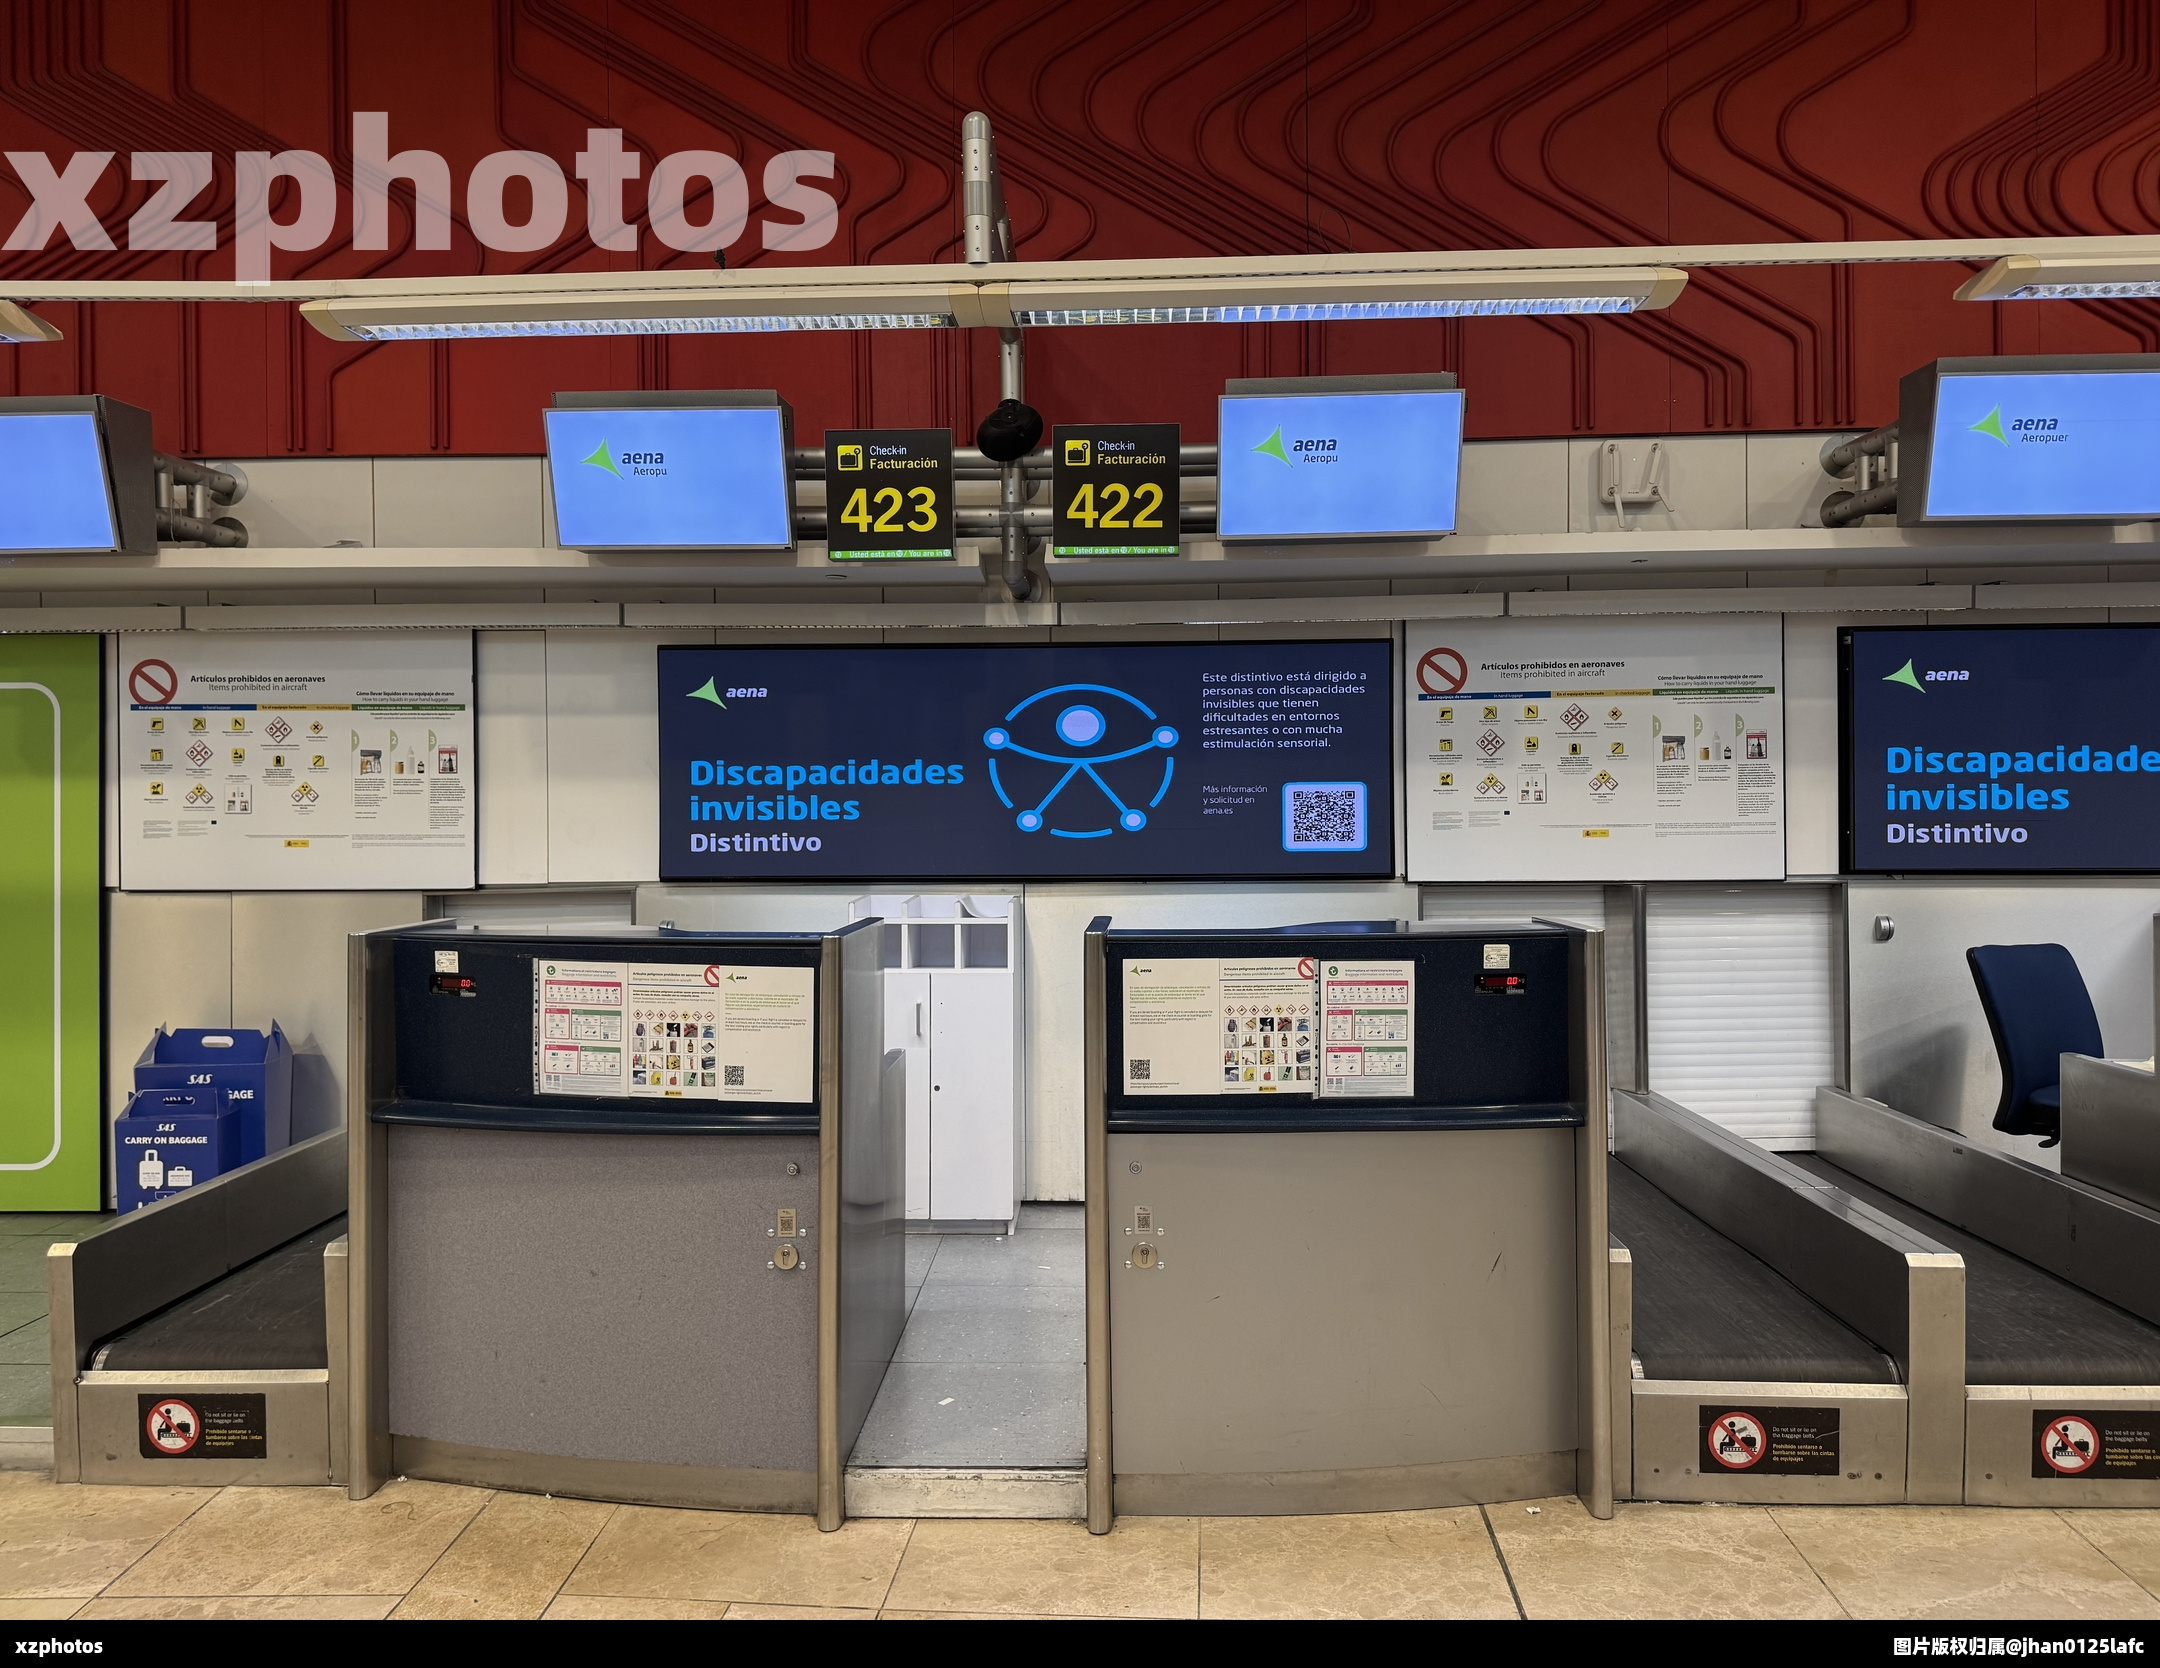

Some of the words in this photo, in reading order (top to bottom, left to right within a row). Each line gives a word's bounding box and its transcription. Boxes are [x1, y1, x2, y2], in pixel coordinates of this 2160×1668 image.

[2012, 418, 2058, 430] aena
[2021, 433, 2068, 444] Aeropuer
[870, 445, 907, 456] Check-in
[1098, 441, 1135, 451] Check-in
[1293, 439, 1337, 451] aena
[622, 452, 664, 464] aena
[870, 458, 938, 469] Facturación
[1097, 453, 1166, 465] Facturación
[1304, 454, 1338, 464] Aeropu
[634, 467, 667, 477] Aeropu
[841, 486, 938, 532] 423
[1067, 482, 1163, 528] 422
[1481, 662, 1519, 671] Artículos
[1520, 661, 1567, 671] prohibidos
[1581, 660, 1625, 668] aeronaves
[190, 675, 227, 683] Artículos
[228, 675, 272, 684] prohibidos
[1202, 673, 1227, 682] Este
[1230, 672, 1283, 682] distintivo
[1286, 671, 1310, 681] está
[1314, 671, 1357, 682] dirigido
[1500, 671, 1522, 679] Items
[1524, 670, 1566, 679] prohibited
[1577, 669, 1605, 677] aircraft
[1924, 670, 1970, 681] aena
[231, 684, 271, 692] prohibited
[281, 683, 307, 691] aircraft
[725, 686, 768, 698] aena
[1203, 687, 1253, 697] personas
[1257, 687, 1276, 695] con
[1280, 685, 1365, 696] discapacidades
[1203, 699, 1255, 709] invisibles
[1258, 700, 1279, 710] que
[1283, 699, 1319, 708] tienen
[1203, 712, 1268, 722] dificultades
[1289, 712, 1340, 721] entornos
[1203, 726, 1269, 735] estresantes
[1305, 725, 1343, 734] mucha
[1655, 722, 1659, 730] 1
[1737, 721, 1742, 729] 3
[1203, 738, 1274, 748] estimulación
[1277, 738, 1331, 747] sensorial.
[1887, 745, 2160, 779] Discapacidade
[691, 759, 964, 791] Discapacidades
[1203, 785, 1219, 793] Más
[1221, 785, 1267, 793] información
[1203, 797, 1208, 805] y
[1210, 796, 1243, 804] solicitud
[1887, 783, 2070, 810] invisibles
[690, 795, 860, 821] invisibles
[1887, 823, 2028, 844] Distintivo
[690, 833, 822, 852] Distintivo
[187, 1074, 213, 1084] SAS
[156, 1123, 176, 1132] SAS
[125, 1136, 152, 1144] CARRY
[154, 1136, 167, 1144] ON
[168, 1136, 208, 1144] BAGGAGE
